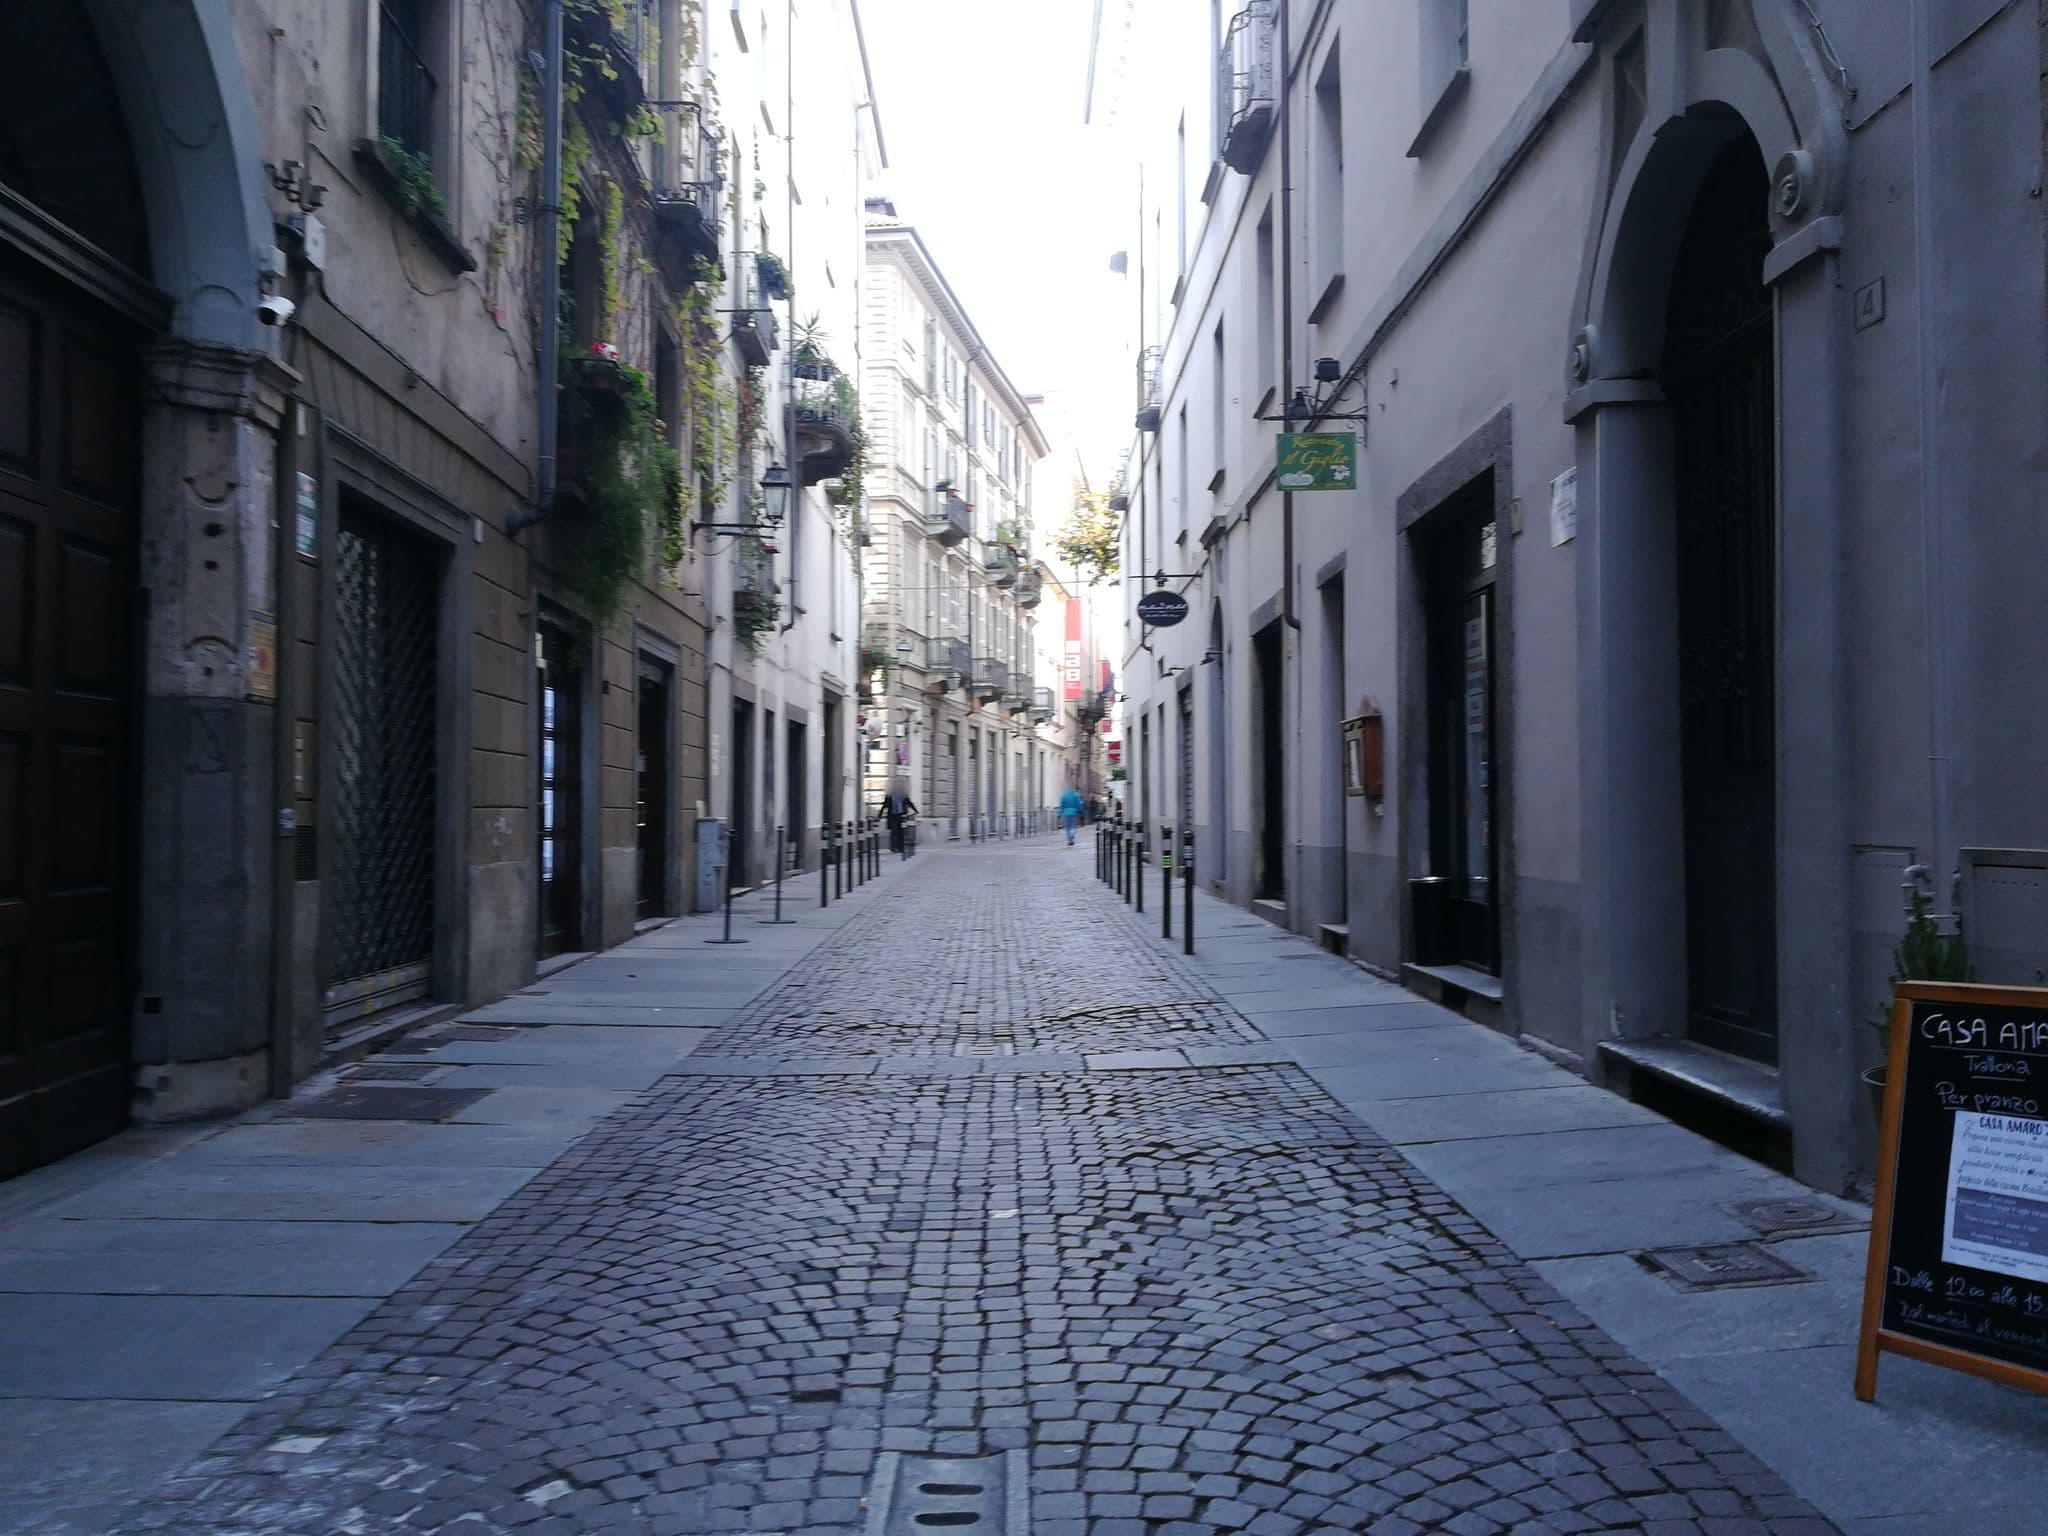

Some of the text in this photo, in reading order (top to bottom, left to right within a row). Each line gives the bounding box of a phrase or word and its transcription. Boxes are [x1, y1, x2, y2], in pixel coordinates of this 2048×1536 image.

[1921, 1013, 1987, 1047] CASA
[1964, 1055, 2031, 1075] Trattoria
[1935, 1081, 2039, 1113] Per pranzo
[1980, 1116, 2043, 1136] CASA AMARO
[1892, 1265, 1934, 1293] Dalle
[1991, 1285, 2019, 1307] alle
